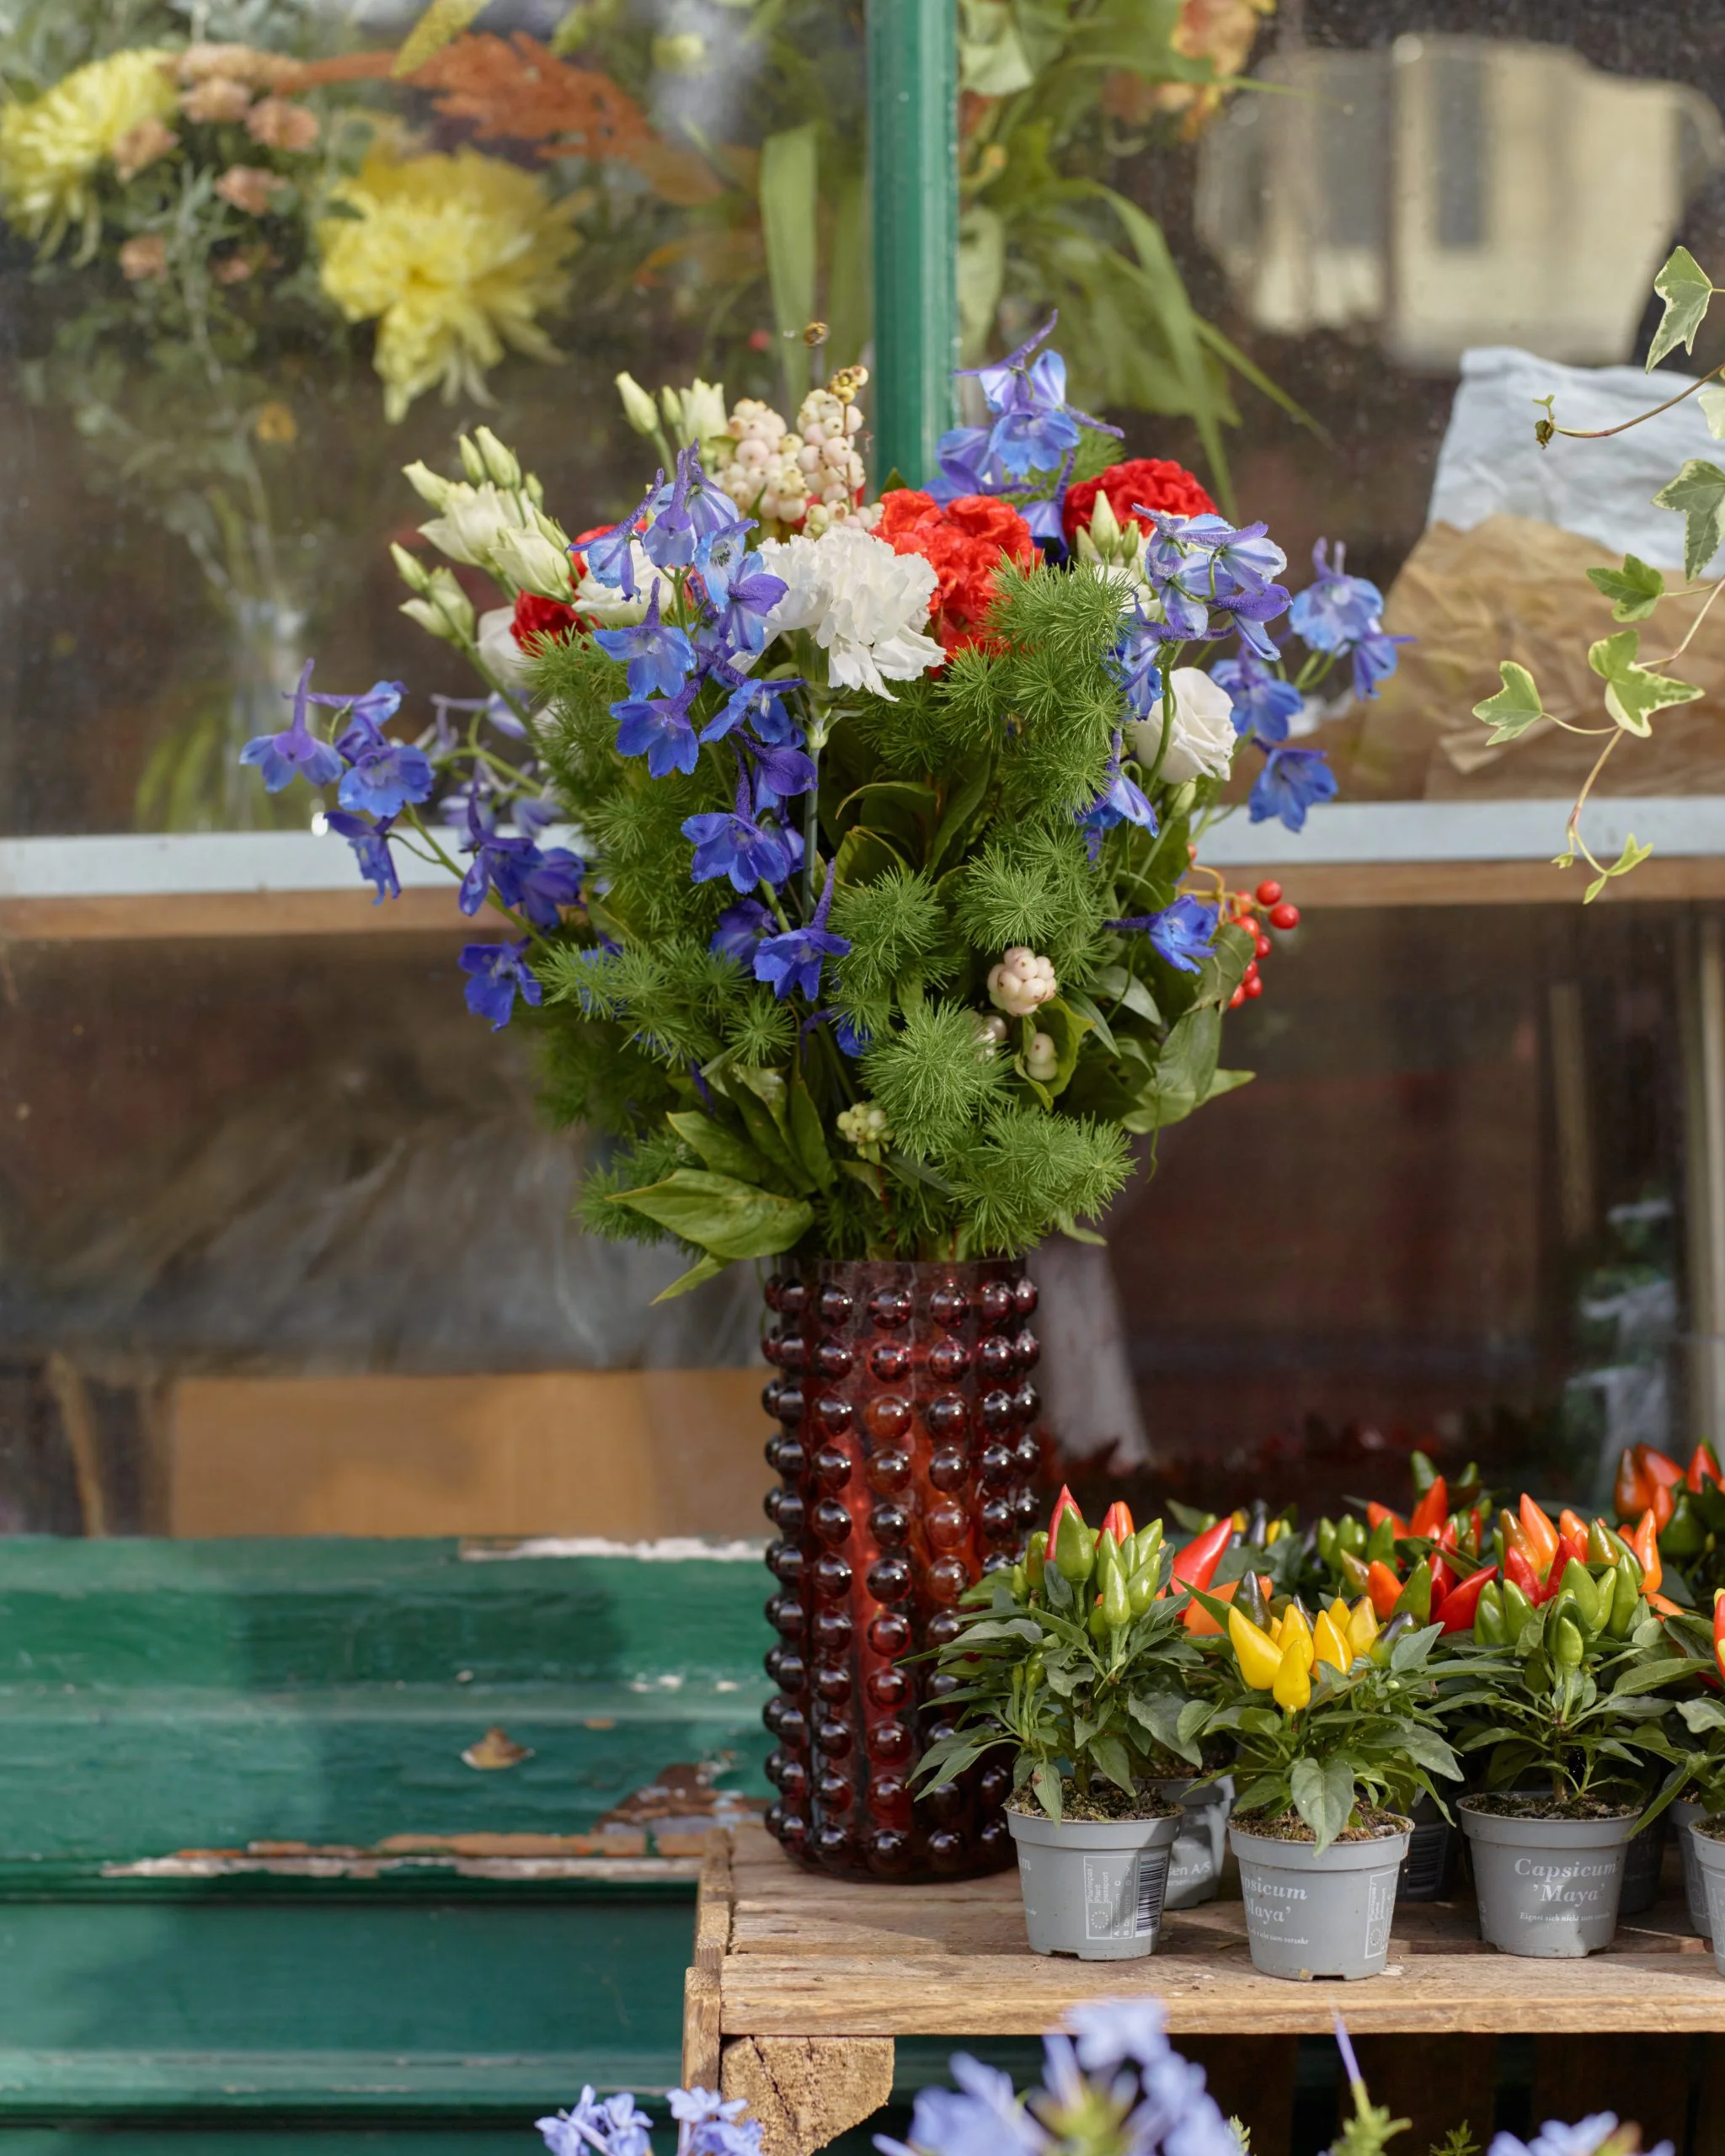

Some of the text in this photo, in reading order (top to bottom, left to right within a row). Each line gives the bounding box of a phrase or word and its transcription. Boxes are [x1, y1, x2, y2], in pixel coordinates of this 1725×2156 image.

[1191, 1860, 1211, 1874] A/S
[1514, 1858, 1616, 1883] Capsicum
[1243, 1876, 1307, 1900] psicum
[1532, 1883, 1605, 1908] 'Maya'
